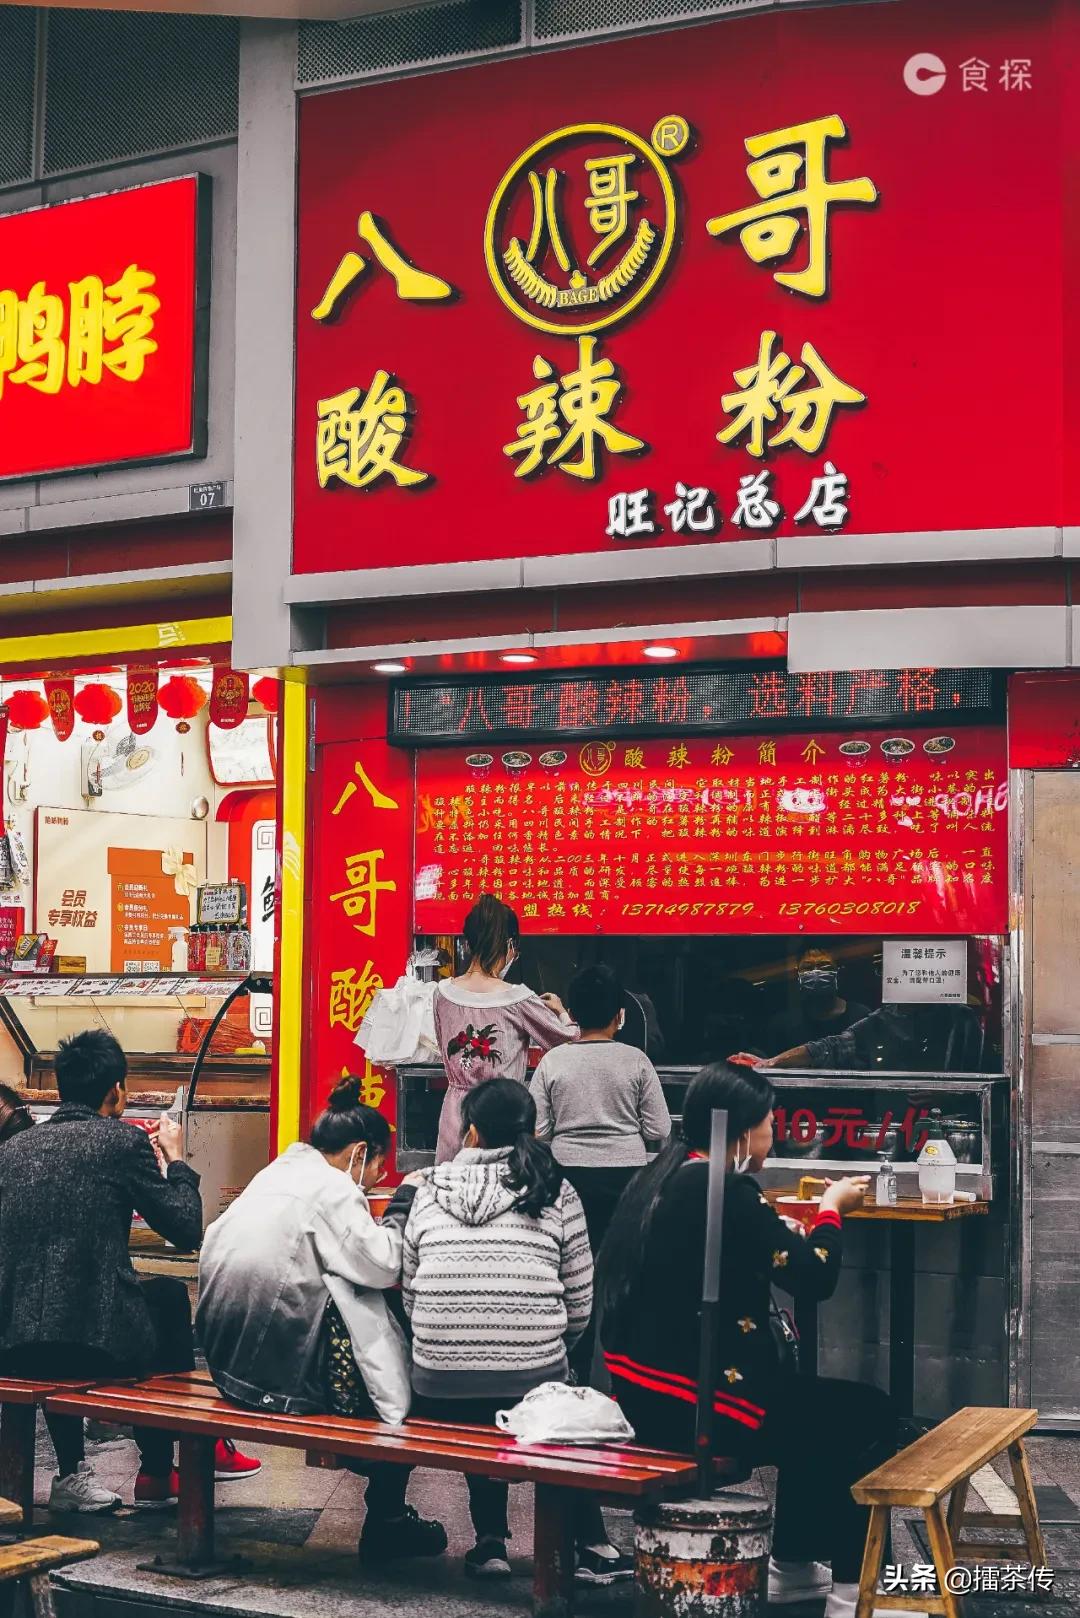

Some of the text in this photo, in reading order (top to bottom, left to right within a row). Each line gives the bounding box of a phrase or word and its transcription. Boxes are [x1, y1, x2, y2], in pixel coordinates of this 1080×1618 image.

[526, 153, 640, 272] 八哥
[558, 287, 600, 308] BAGE
[0, 263, 161, 398] 鸭脖
[315, 331, 867, 489] 酸辣粉
[200, 492, 215, 506] 07
[606, 463, 850, 537] 旺记总店
[129, 682, 155, 694] 2020
[61, 889, 87, 908] 会员
[778, 901, 922, 916] 13760308018
[48, 908, 98, 928] 专享权益
[901, 948, 947, 959] 温馨提示
